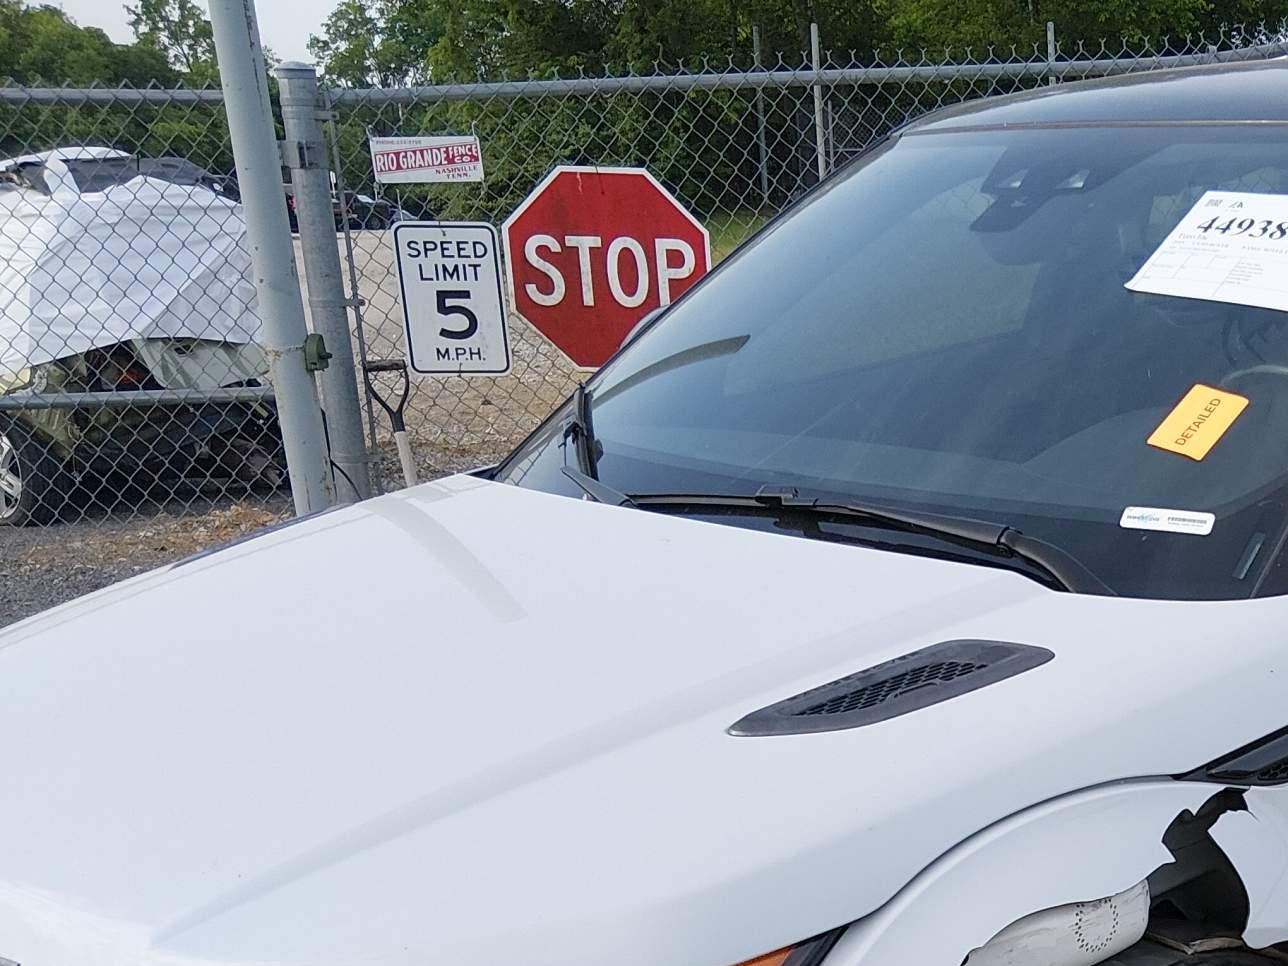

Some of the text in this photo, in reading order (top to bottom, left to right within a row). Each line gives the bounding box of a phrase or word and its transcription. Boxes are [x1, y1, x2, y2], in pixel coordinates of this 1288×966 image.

[375, 144, 478, 172] RIO GRANDE FENCE
[454, 155, 475, 163] CO.
[435, 166, 477, 175] NASHVILLE
[406, 240, 489, 260] SPEED
[417, 263, 482, 282] LIMIT
[523, 234, 697, 308] STOP
[435, 289, 479, 340] 5
[435, 346, 486, 361] M.P.H.
[1174, 398, 1222, 446] DETAILED
